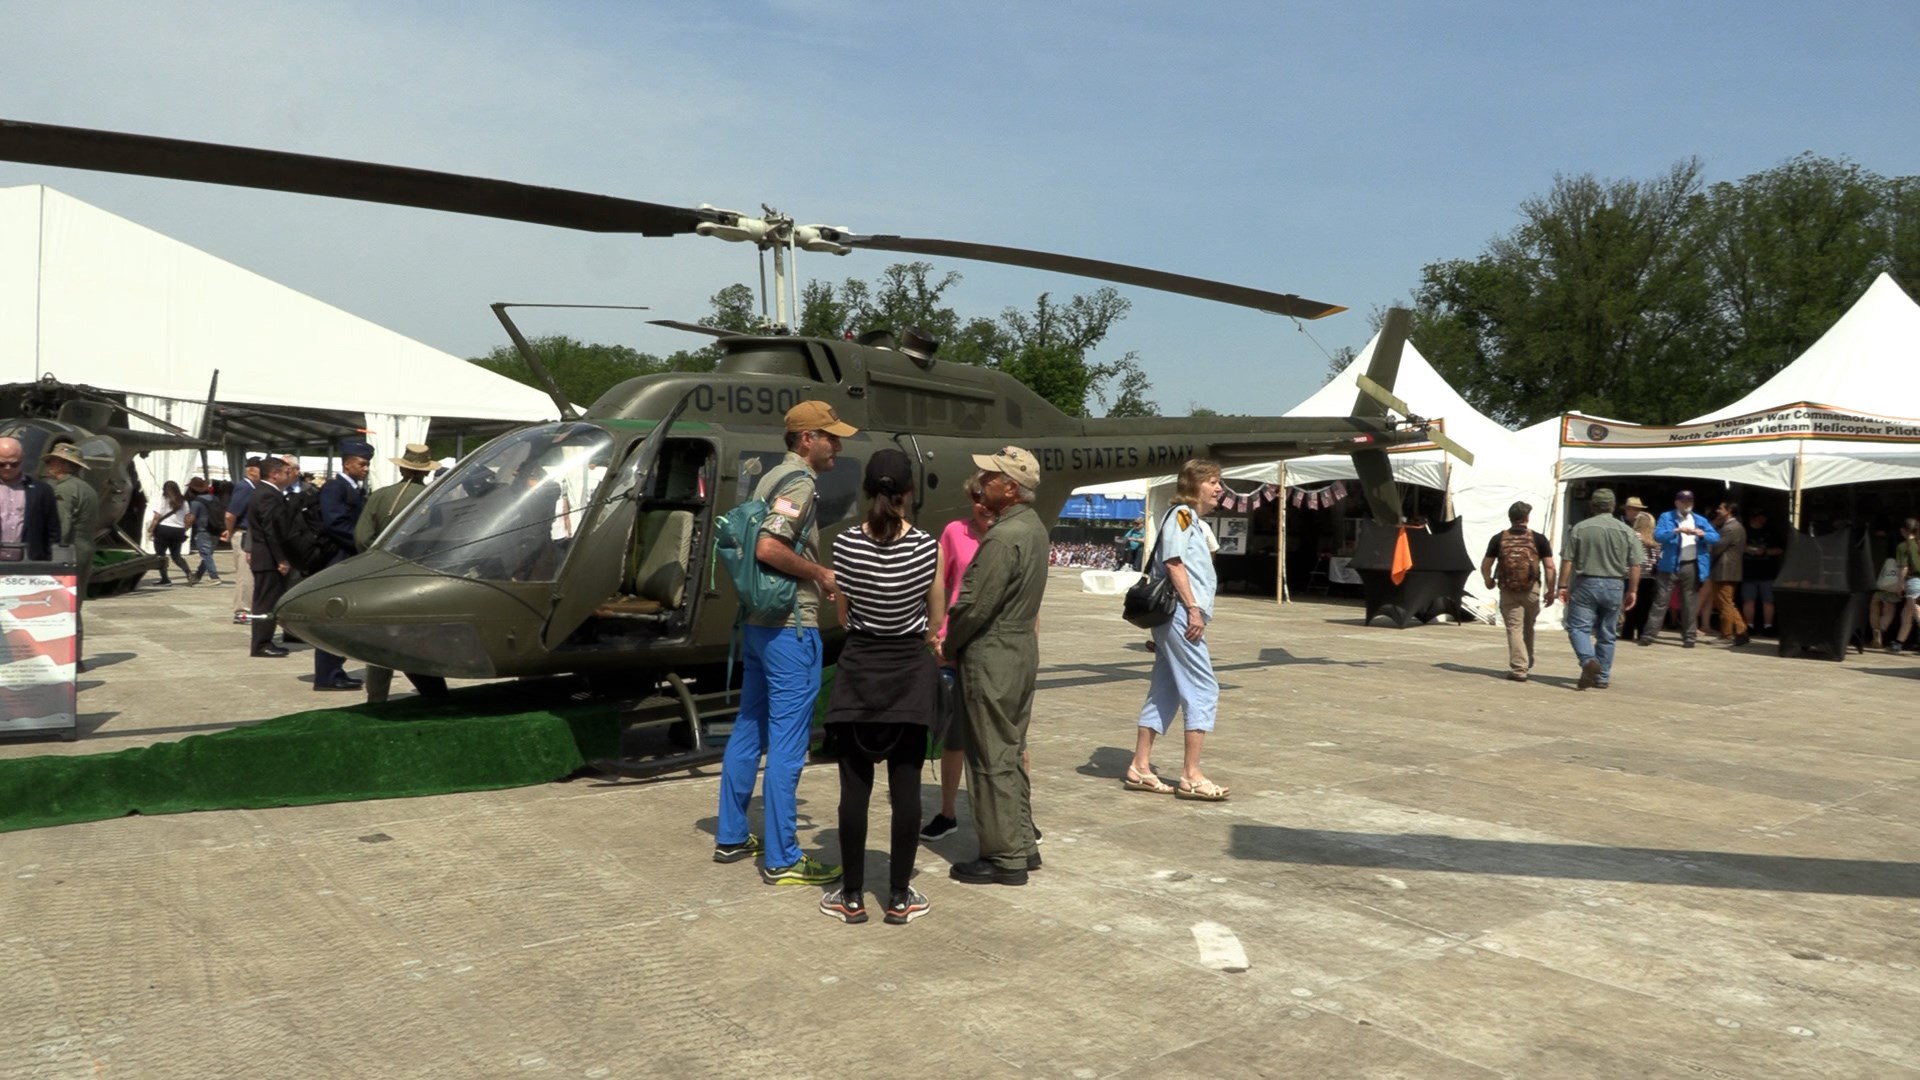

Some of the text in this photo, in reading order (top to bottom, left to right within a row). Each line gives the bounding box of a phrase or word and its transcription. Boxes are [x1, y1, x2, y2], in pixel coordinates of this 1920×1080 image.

[1767, 411, 1790, 421] War
[1669, 422, 1920, 441] North Carolina Vietnam Helicopter Pilot
[1072, 447, 1139, 470] STATES
[1147, 445, 1194, 466] ARMY
